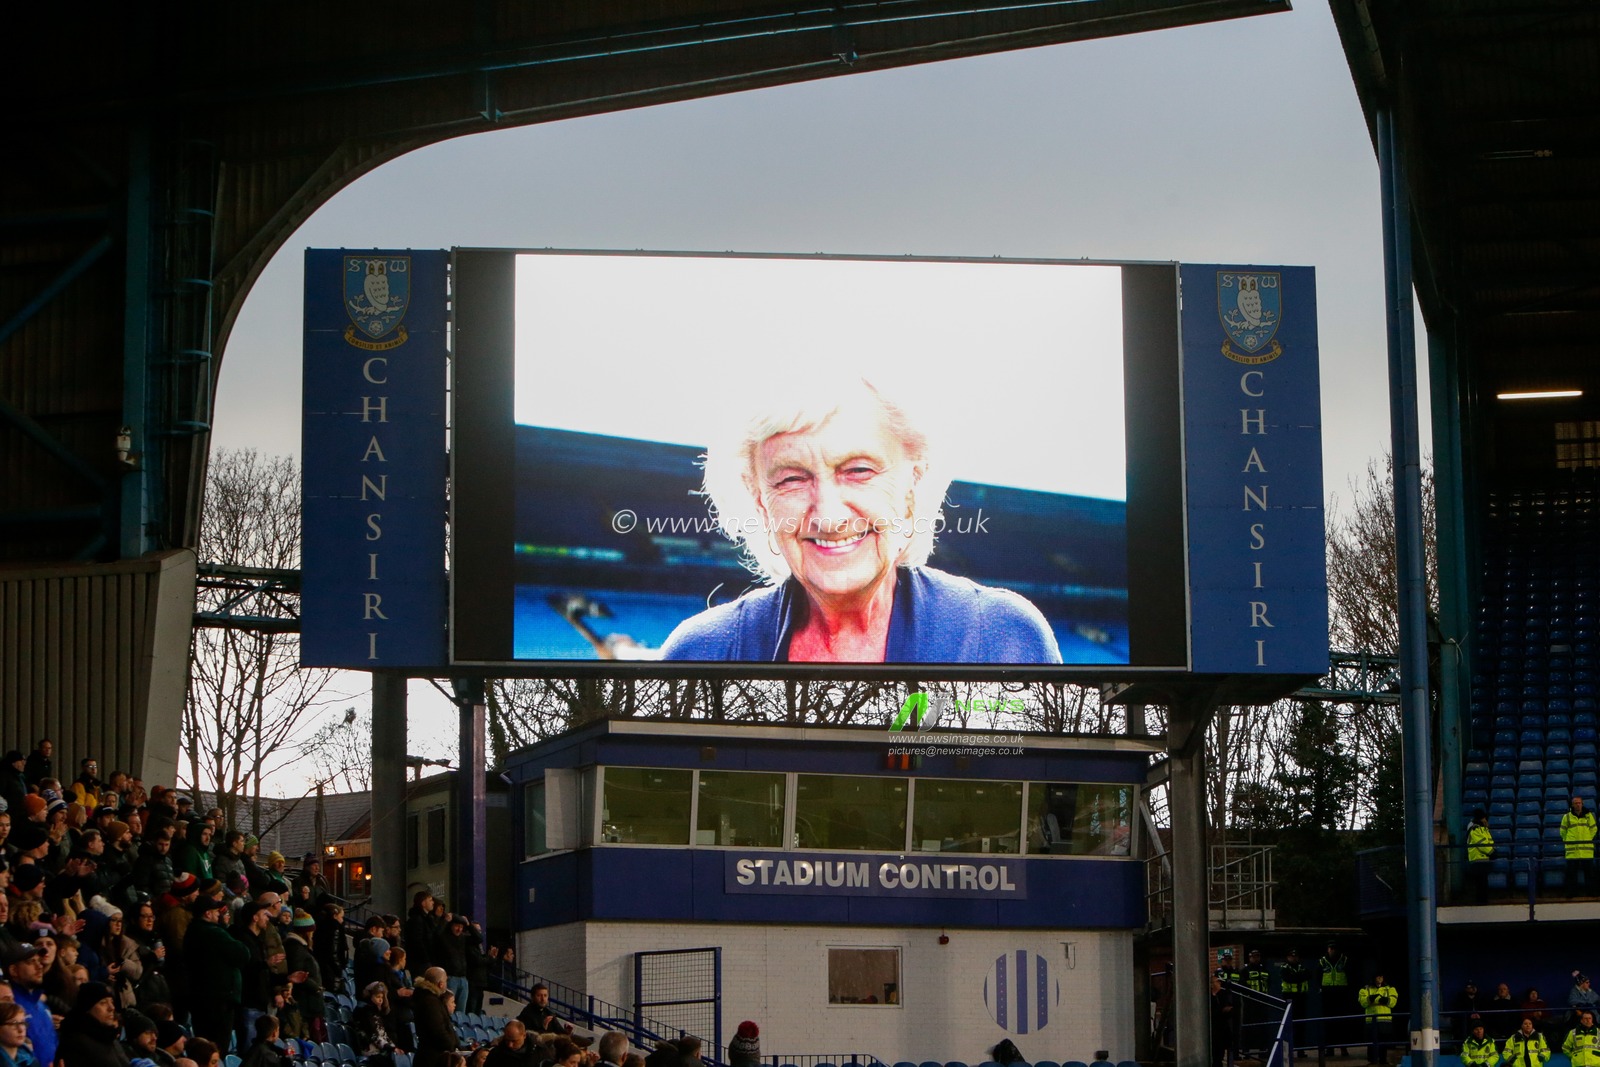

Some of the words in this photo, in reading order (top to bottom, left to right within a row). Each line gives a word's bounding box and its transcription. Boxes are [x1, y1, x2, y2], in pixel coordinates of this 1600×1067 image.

[360, 357, 389, 660] CHANSIRI
[1239, 371, 1275, 667] CHANSIRI
[736, 859, 870, 888] STADIUM
[878, 862, 1016, 891] CONTROL
